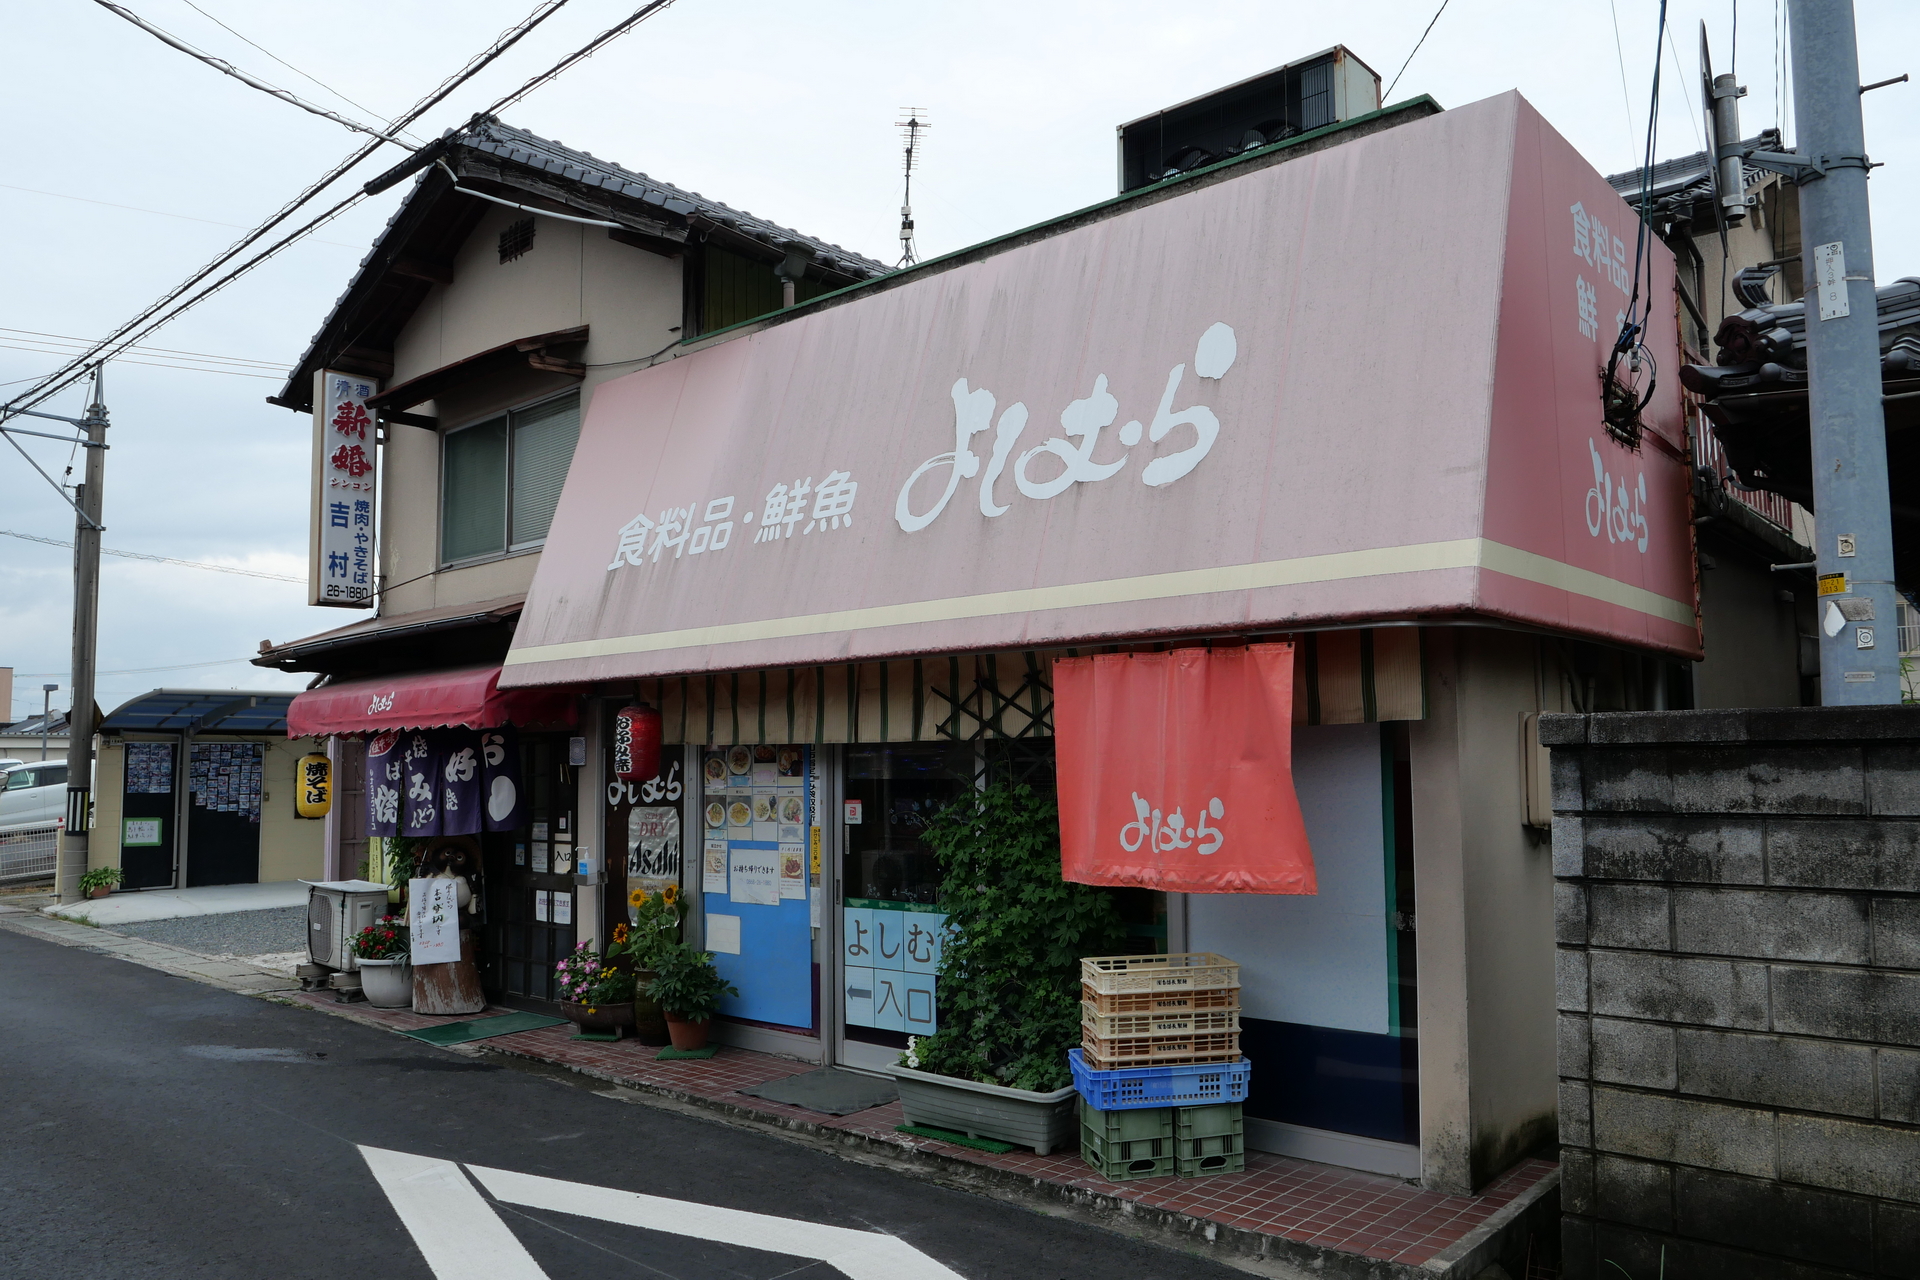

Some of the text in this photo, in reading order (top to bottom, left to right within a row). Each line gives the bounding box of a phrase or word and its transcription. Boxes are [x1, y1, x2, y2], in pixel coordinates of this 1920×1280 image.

[1570, 201, 1630, 297] 食料品
[335, 379, 370, 398] 清酒
[331, 400, 373, 478] 新婚
[894, 321, 1238, 532] よしむら
[329, 477, 372, 492] シンコン
[328, 501, 351, 579] 吉村
[353, 499, 370, 585] 焼肉・やきそば
[607, 469, 859, 572] 食料品・鮮魚
[326, 584, 368, 600] 26-1880
[305, 761, 328, 804] 焼そば
[1119, 791, 1225, 855] よしむら
[554, 850, 572, 862] 入口
[629, 839, 678, 876] Asahi
[876, 980, 933, 1024] 入口
